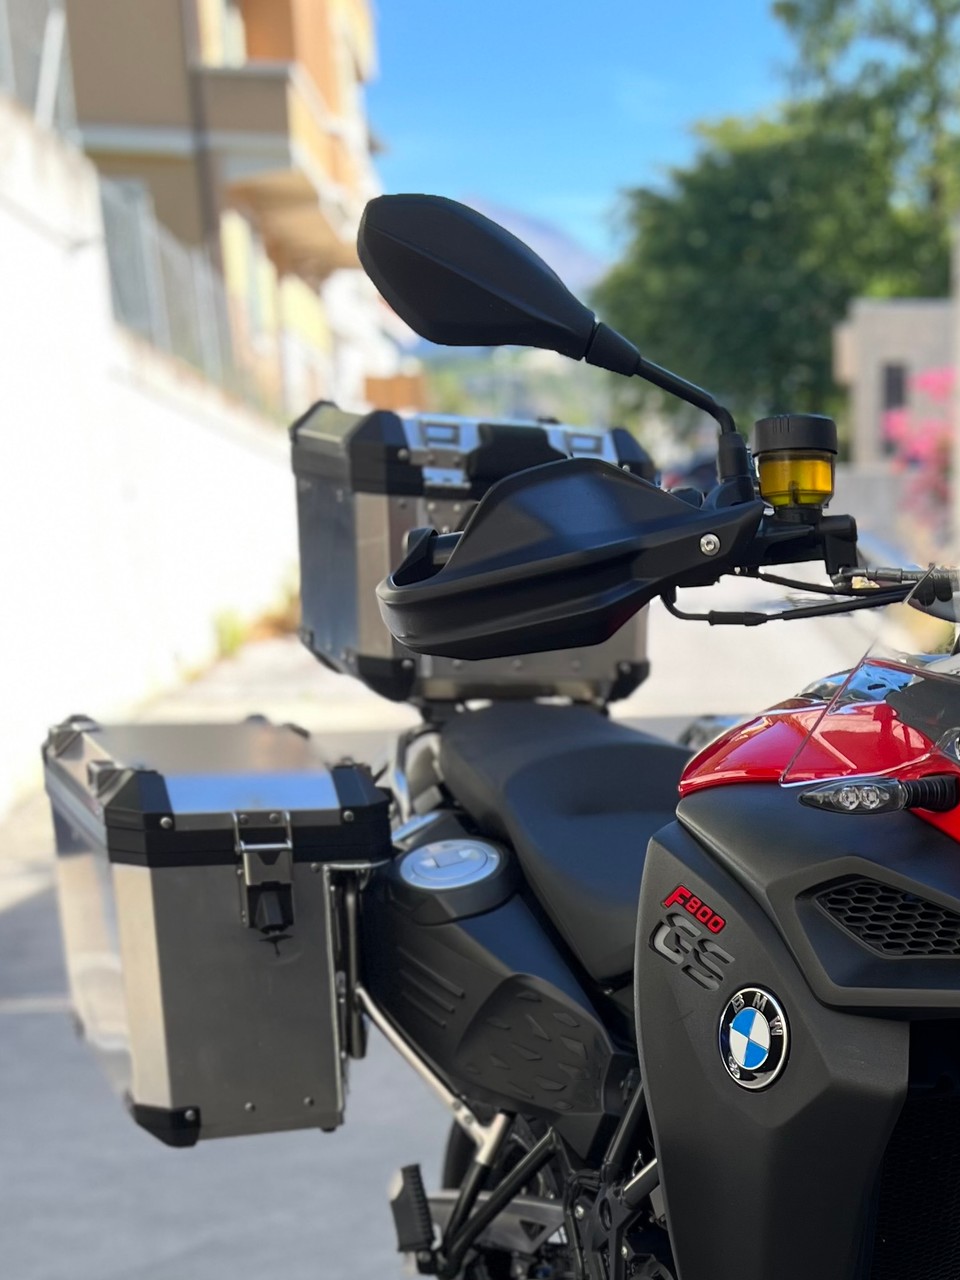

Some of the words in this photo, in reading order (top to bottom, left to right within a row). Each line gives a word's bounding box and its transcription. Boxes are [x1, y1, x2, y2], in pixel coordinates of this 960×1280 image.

[663, 884, 727, 934] F800
[649, 912, 736, 991] GS
[731, 991, 783, 1036] BMW
